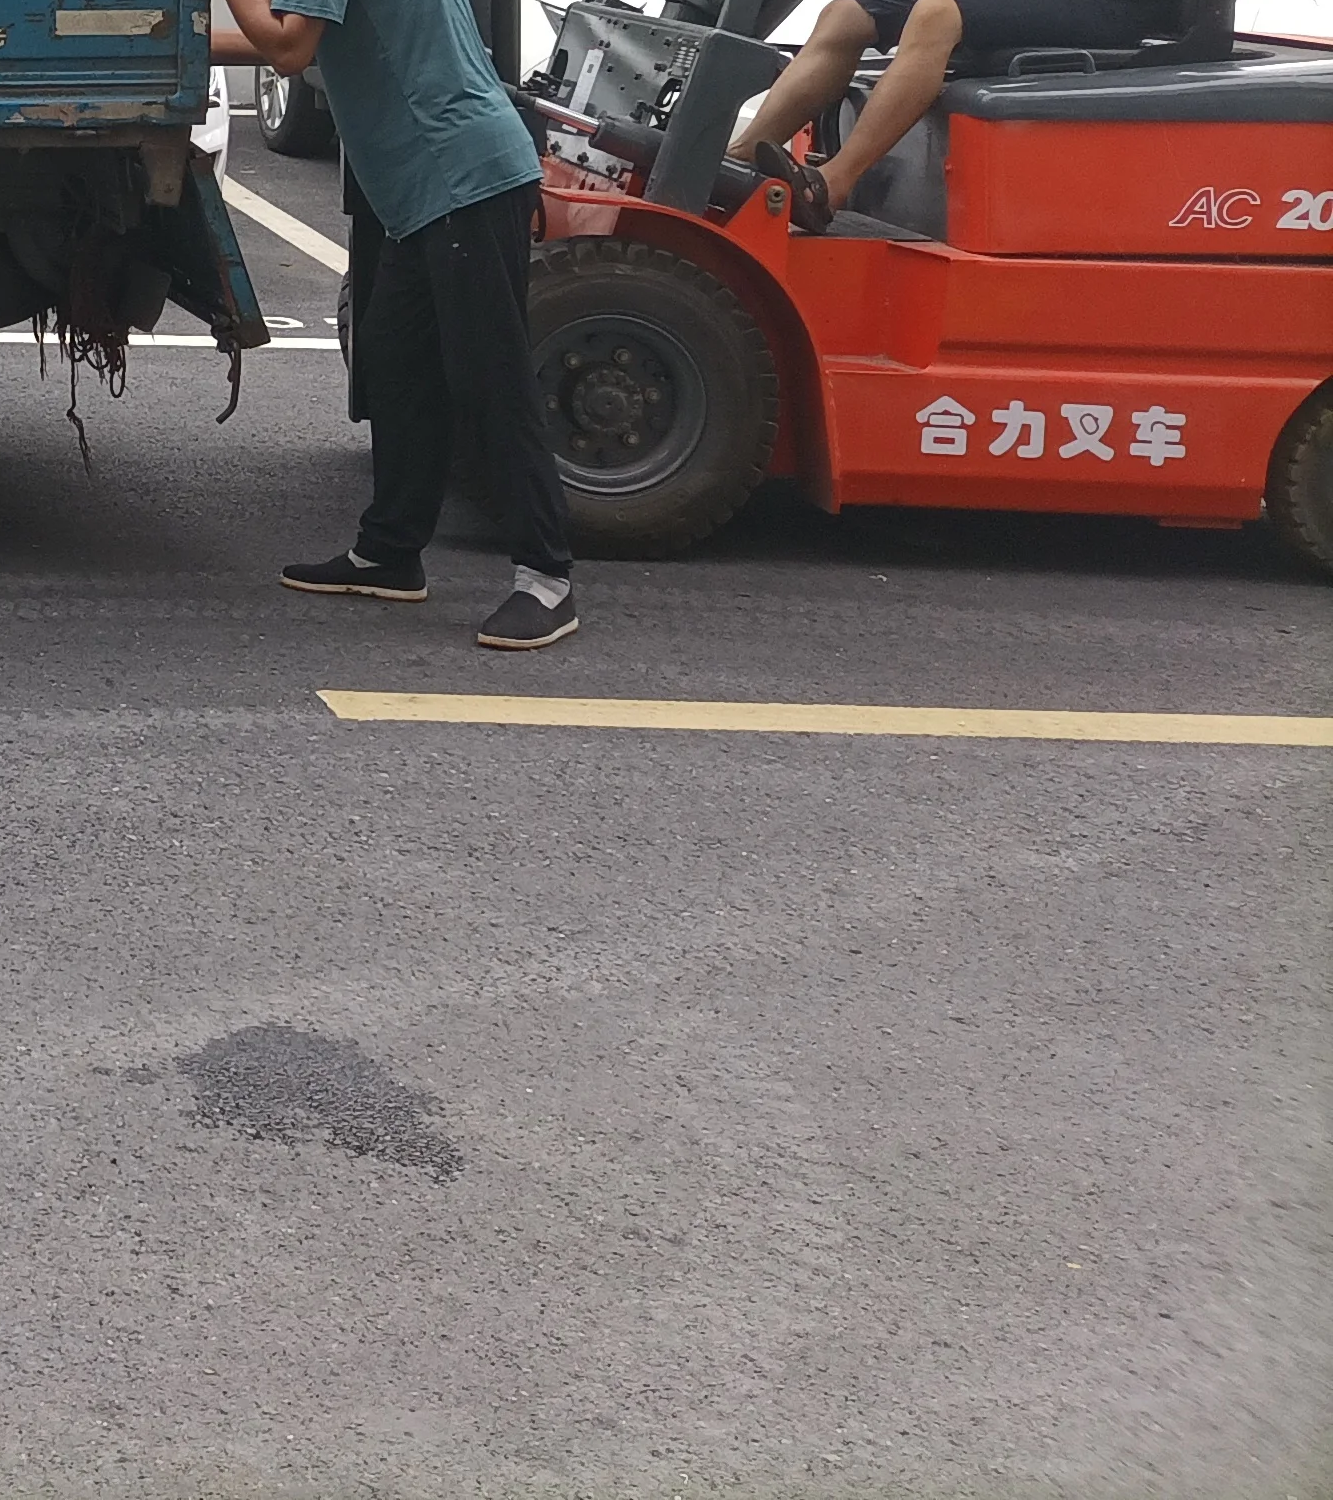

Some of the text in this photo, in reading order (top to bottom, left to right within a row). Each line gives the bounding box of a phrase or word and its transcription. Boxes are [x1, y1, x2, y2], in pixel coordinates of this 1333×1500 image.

[1168, 187, 1333, 231] AC 20
[915, 395, 1186, 467] 合力叉车
